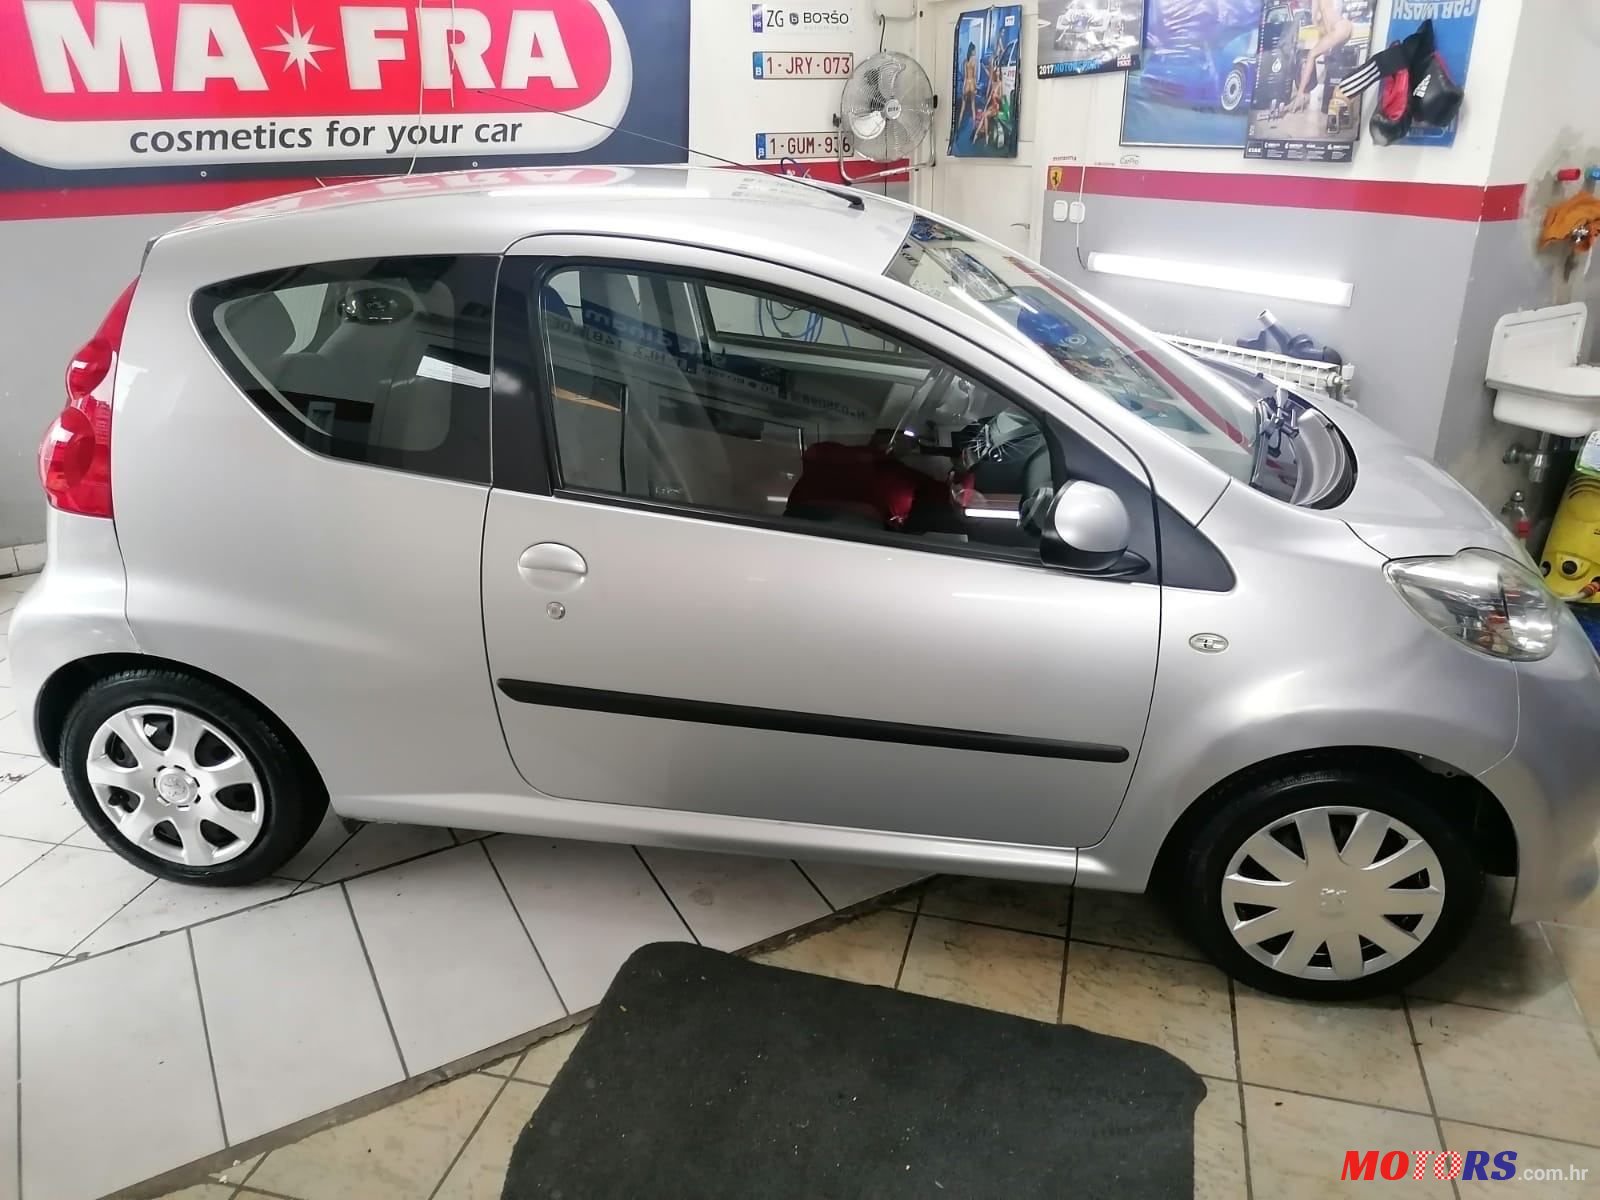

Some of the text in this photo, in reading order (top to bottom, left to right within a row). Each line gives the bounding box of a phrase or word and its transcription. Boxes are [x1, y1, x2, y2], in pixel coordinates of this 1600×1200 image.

[766, 10, 784, 27] ZG
[23, 0, 579, 93] MA FRA
[756, 67, 762, 75] B
[1039, 64, 1055, 75] 2017
[129, 120, 522, 153] cosmetics for your car
